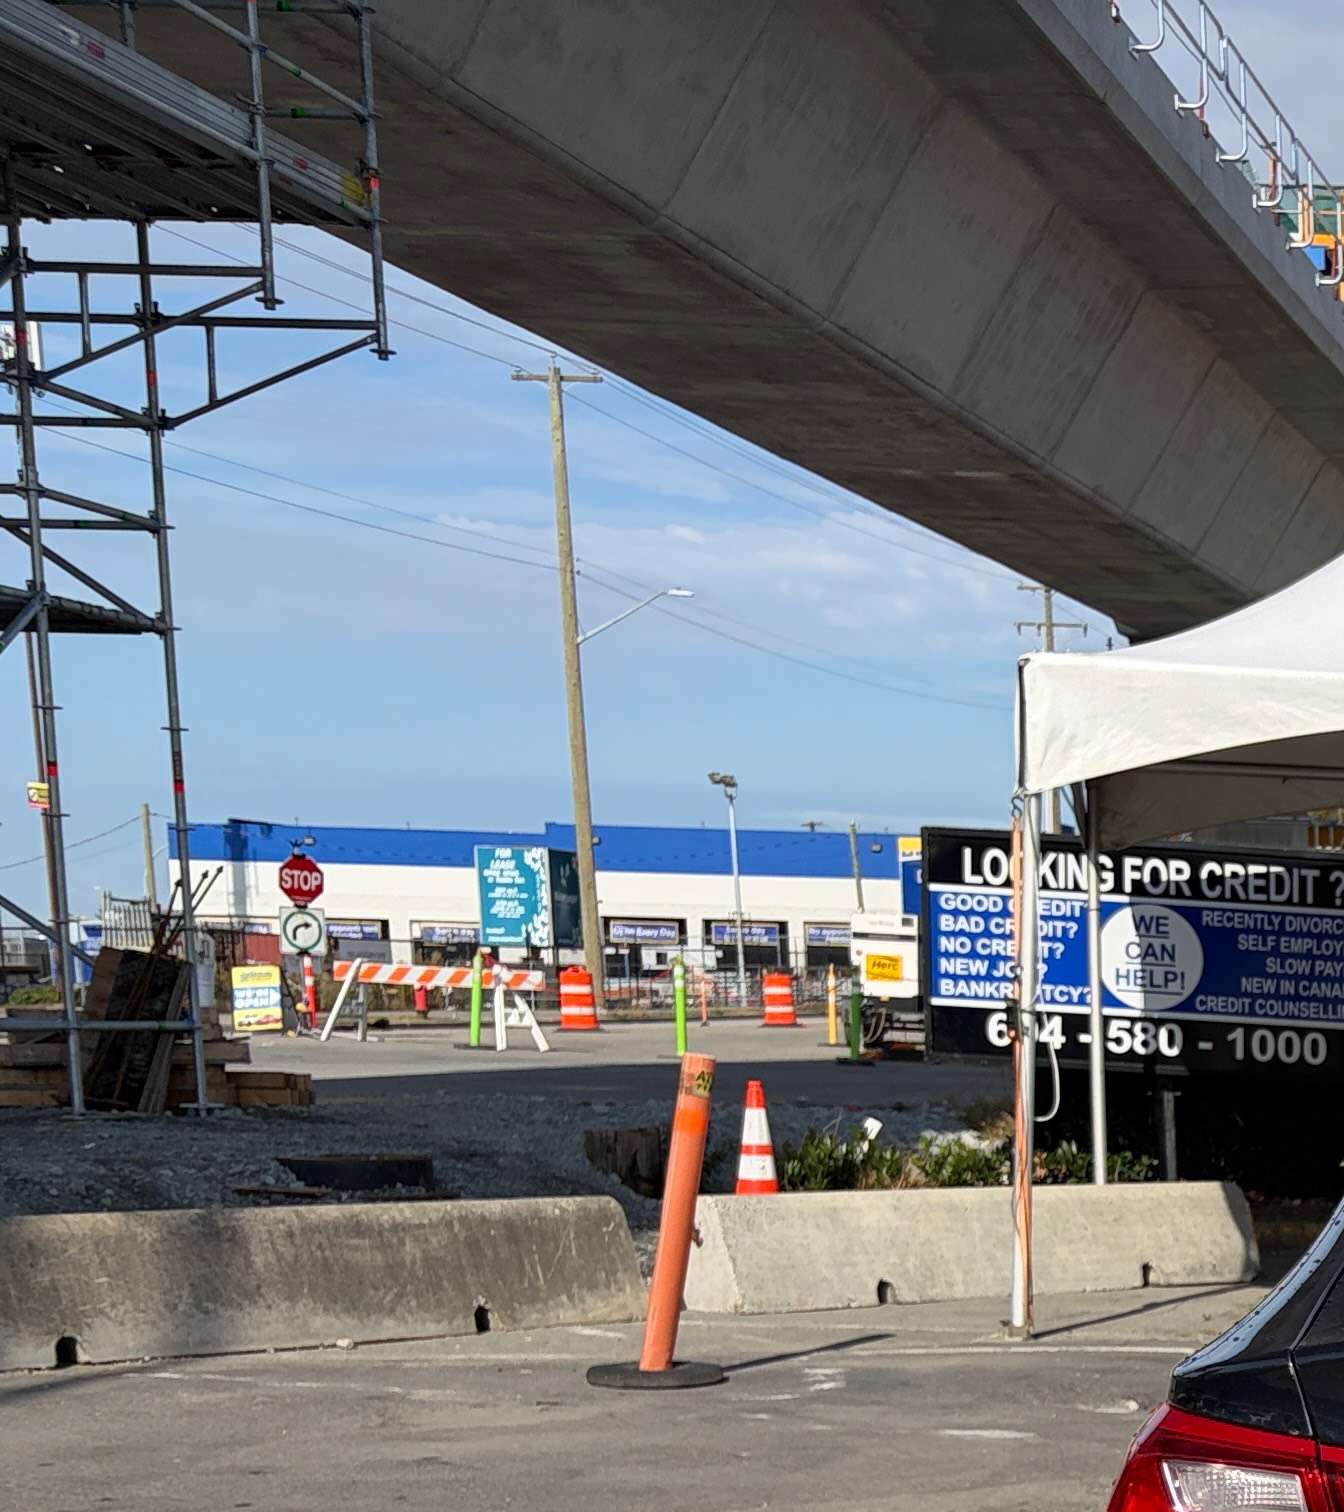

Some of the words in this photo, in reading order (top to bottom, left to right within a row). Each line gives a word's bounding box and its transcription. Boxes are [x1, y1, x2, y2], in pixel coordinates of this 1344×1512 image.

[281, 868, 322, 891] STOP
[962, 846, 1115, 892] LOKING
[1122, 856, 1192, 896] FOR
[1200, 861, 1320, 904] CREDIT
[940, 894, 1003, 912] GOOD
[939, 915, 985, 933] BAD
[989, 917, 1078, 939] CRDIT?
[1133, 914, 1169, 935] WE
[1202, 910, 1281, 931] RECENTLY
[939, 936, 972, 953] NO
[976, 938, 1065, 959] CRET?
[1125, 942, 1176, 962] CAN
[1237, 934, 1277, 952] SELF
[939, 958, 989, 976] NEW
[993, 960, 1048, 980] JO?
[1265, 957, 1311, 975] SLOW
[1116, 968, 1185, 990] HELP!
[1241, 977, 1277, 994] NEW
[1280, 980, 1295, 996] IN
[939, 979, 1091, 1003] BANKRTCY?
[1195, 995, 1252, 1013] CREDIT
[986, 1012, 1066, 1050] 64
[1106, 1019, 1183, 1057] 580
[1227, 1027, 1328, 1066] 1000
